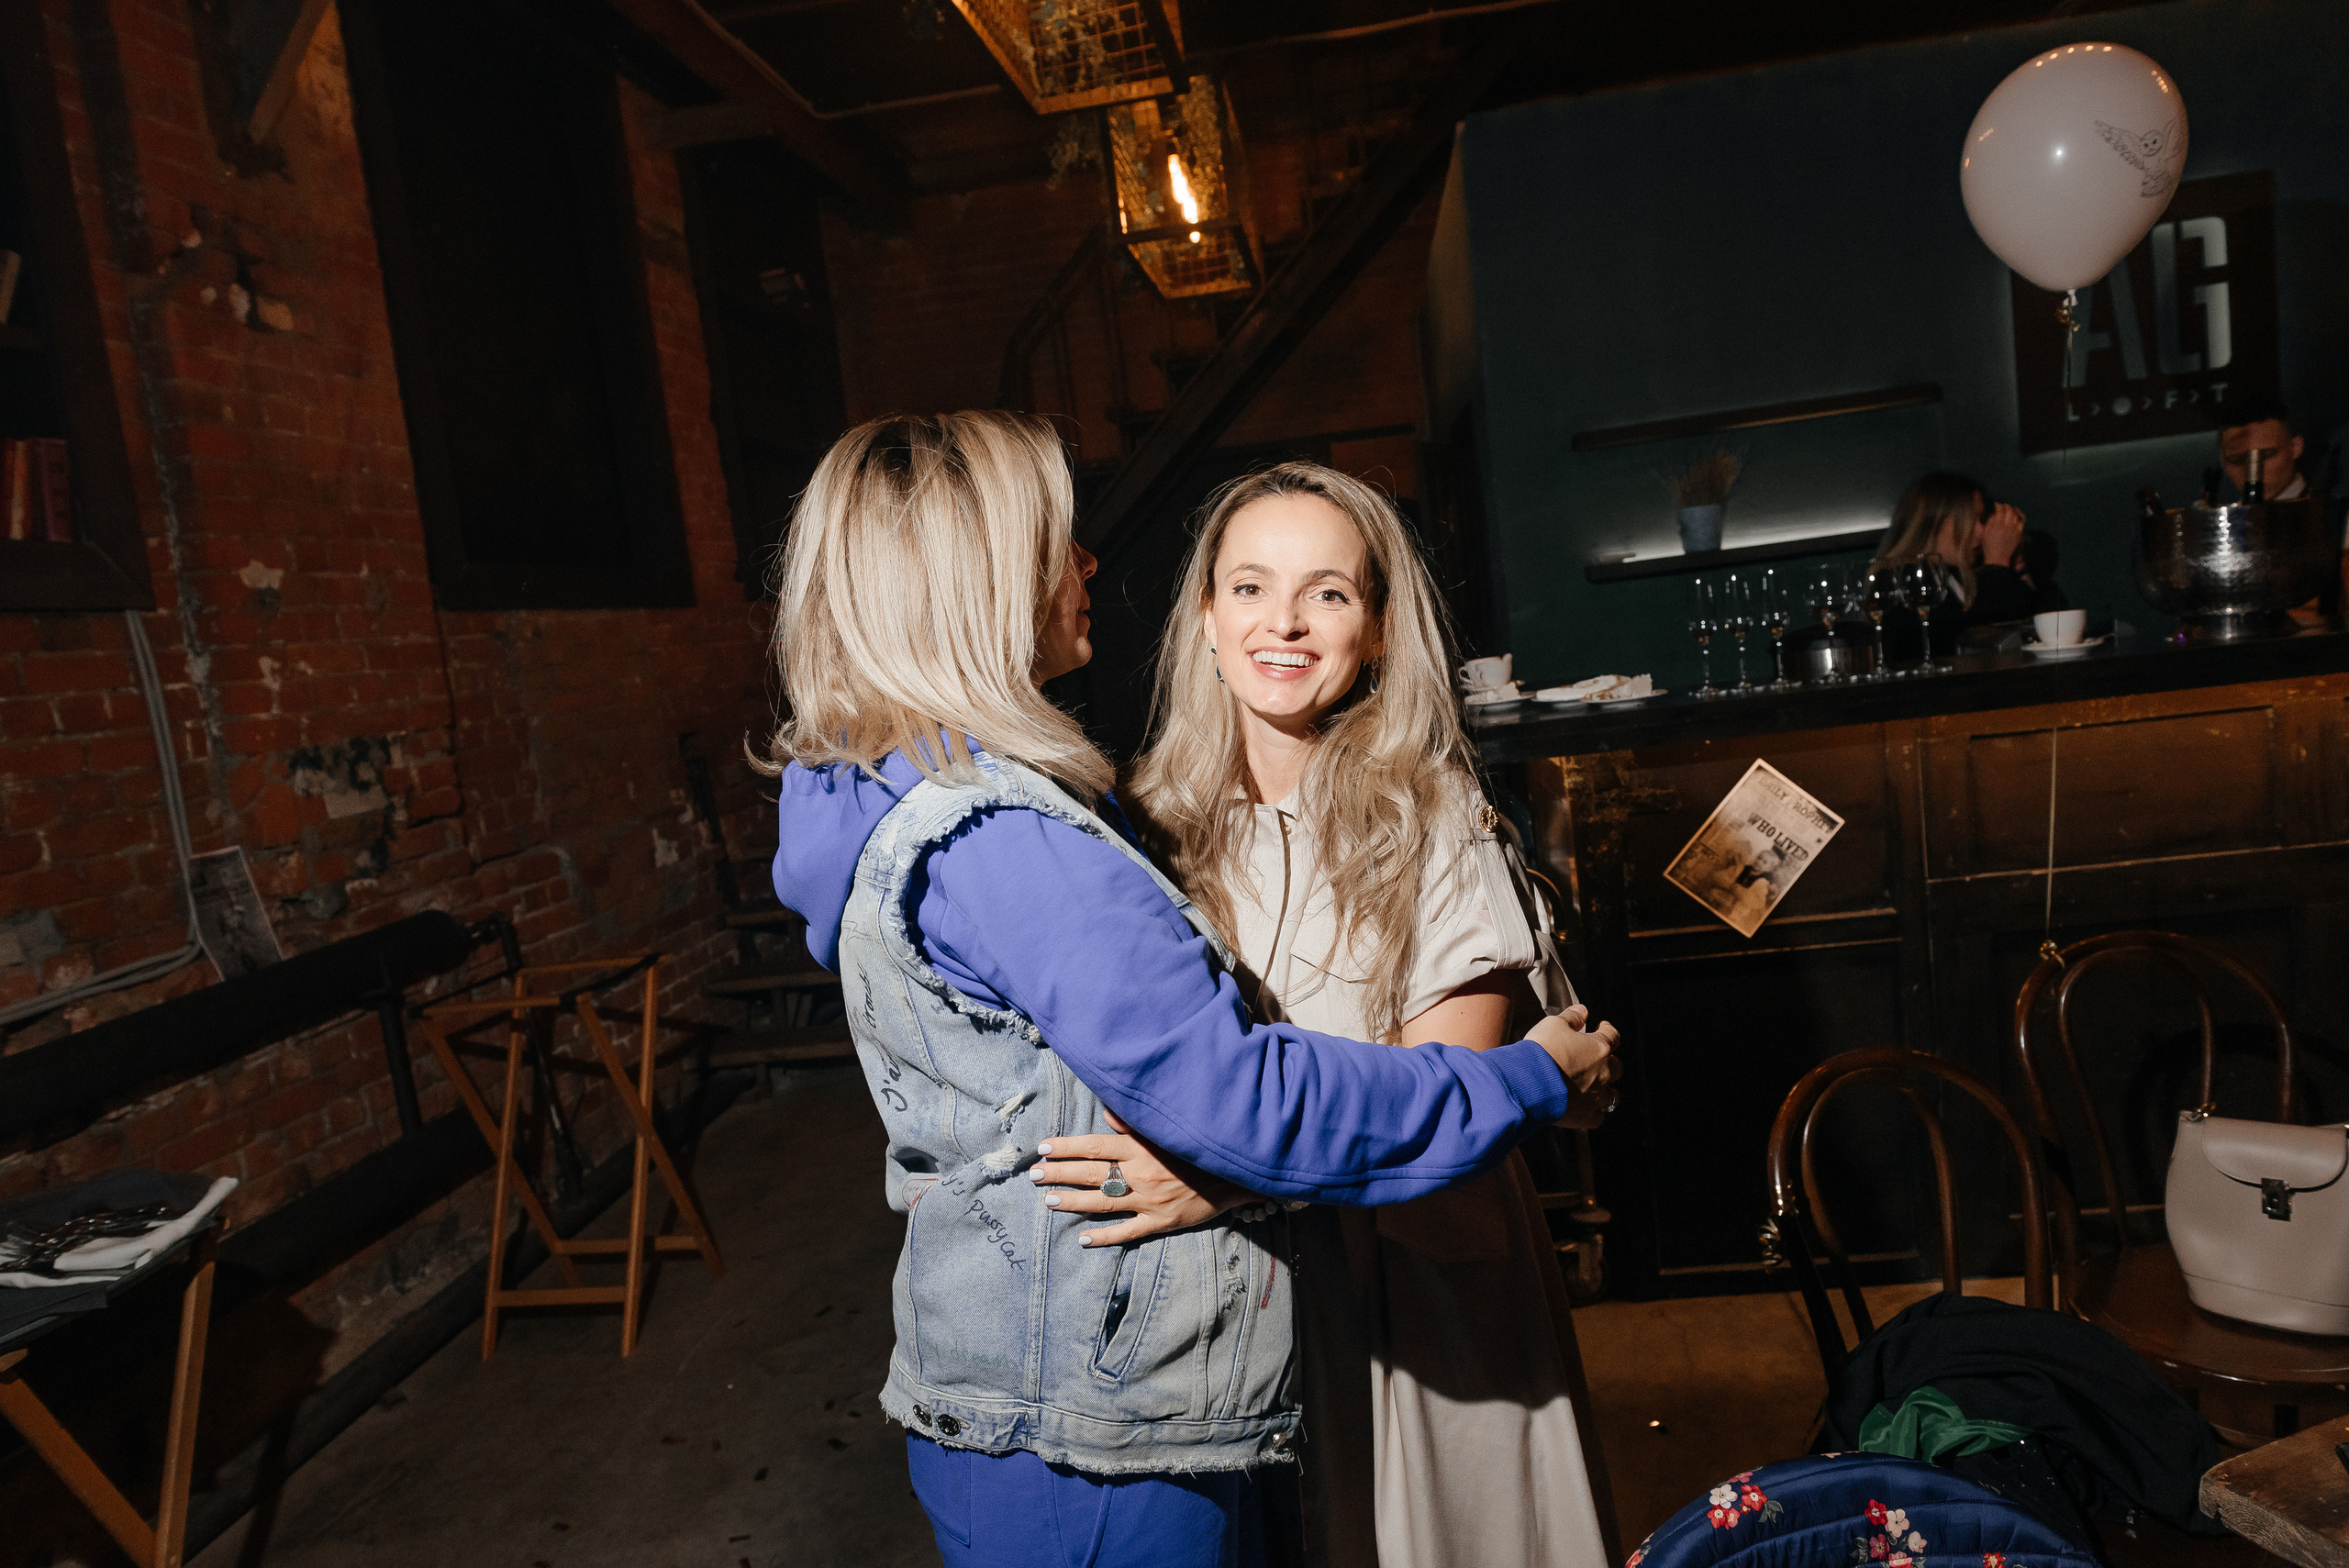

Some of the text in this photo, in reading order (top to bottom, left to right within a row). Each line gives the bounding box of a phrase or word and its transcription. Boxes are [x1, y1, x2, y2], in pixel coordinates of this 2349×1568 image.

[2061, 216, 2232, 390] AG
[1747, 812, 1776, 838] WHO
[1773, 832, 1809, 862] LIVED
